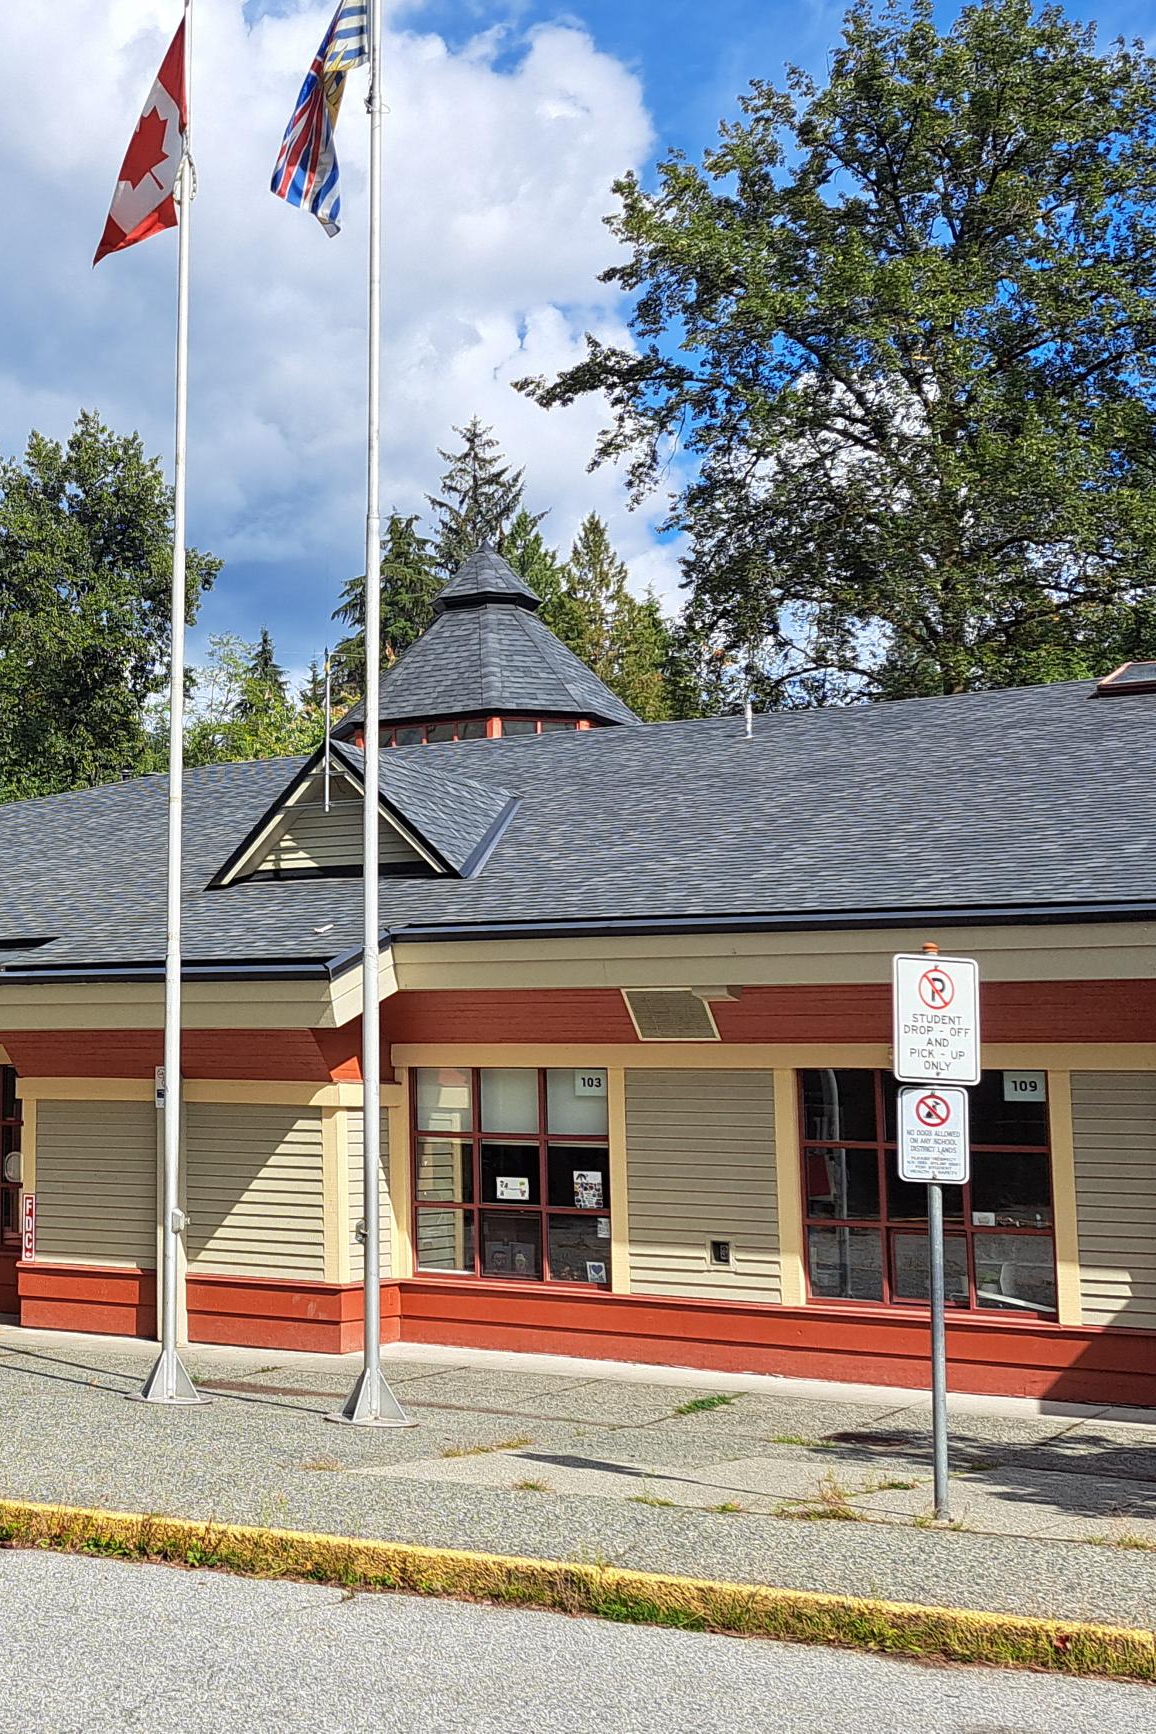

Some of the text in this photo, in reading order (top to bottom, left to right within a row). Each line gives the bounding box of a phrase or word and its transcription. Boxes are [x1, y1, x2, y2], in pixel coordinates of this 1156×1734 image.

[912, 1013, 962, 1025] STUDENT
[903, 1024, 934, 1035] DROP
[949, 1027, 971, 1037] OFF
[926, 1037, 950, 1048] AND
[909, 1048, 935, 1059] PICK
[950, 1050, 966, 1060] UP
[923, 1060, 952, 1071] ONLY
[581, 1077, 602, 1088] 103
[1011, 1080, 1038, 1092] 109
[916, 1129, 933, 1137] DOGS
[934, 1130, 961, 1138] ALLOWED
[932, 1138, 958, 1146] SCHOOL
[936, 1146, 957, 1154] LANDS
[25, 1198, 33, 1249] FDC
